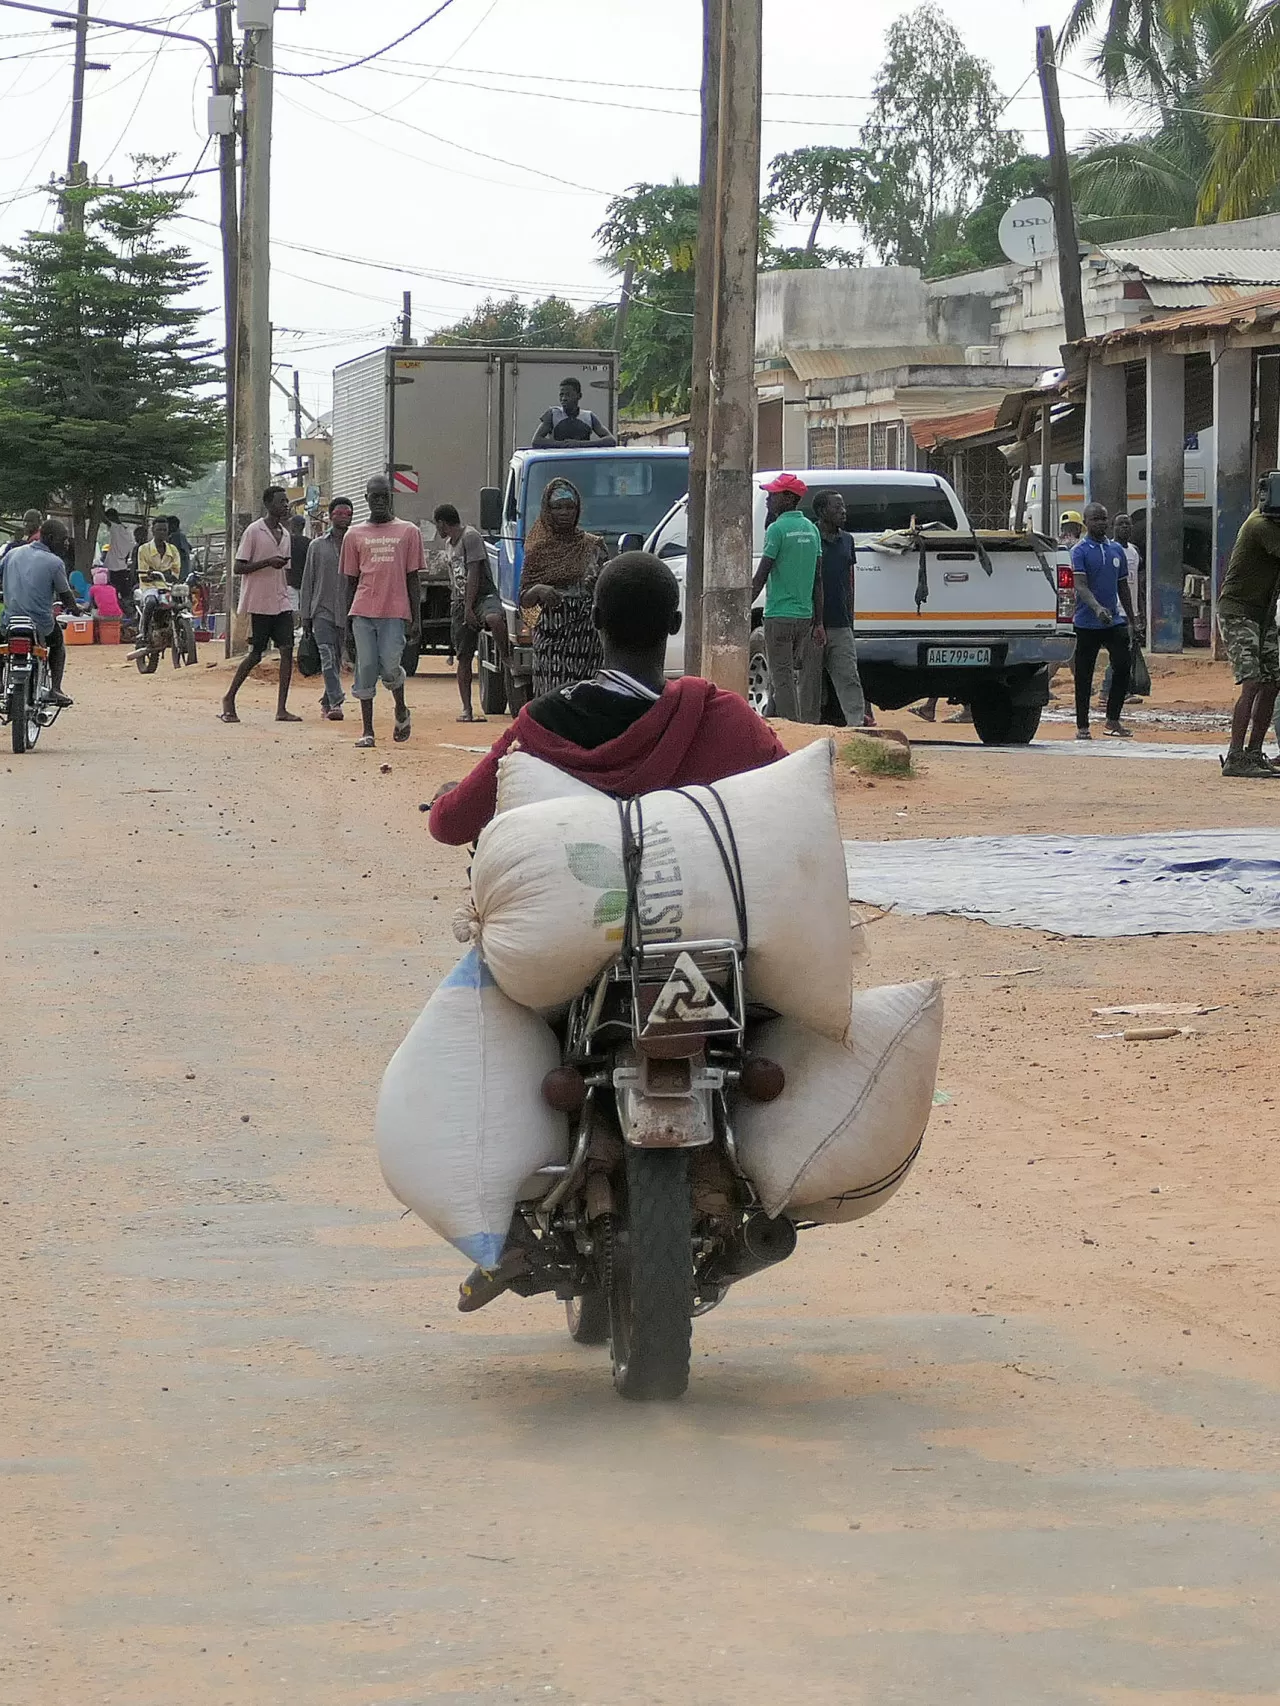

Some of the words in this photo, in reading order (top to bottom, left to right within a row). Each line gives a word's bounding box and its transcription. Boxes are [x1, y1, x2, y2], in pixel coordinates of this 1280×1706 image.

[365, 536, 400, 545] bonjour
[929, 650, 948, 663] AAE
[950, 650, 969, 663] 799
[977, 650, 990, 663] CA
[635, 820, 684, 945] USTENTA
